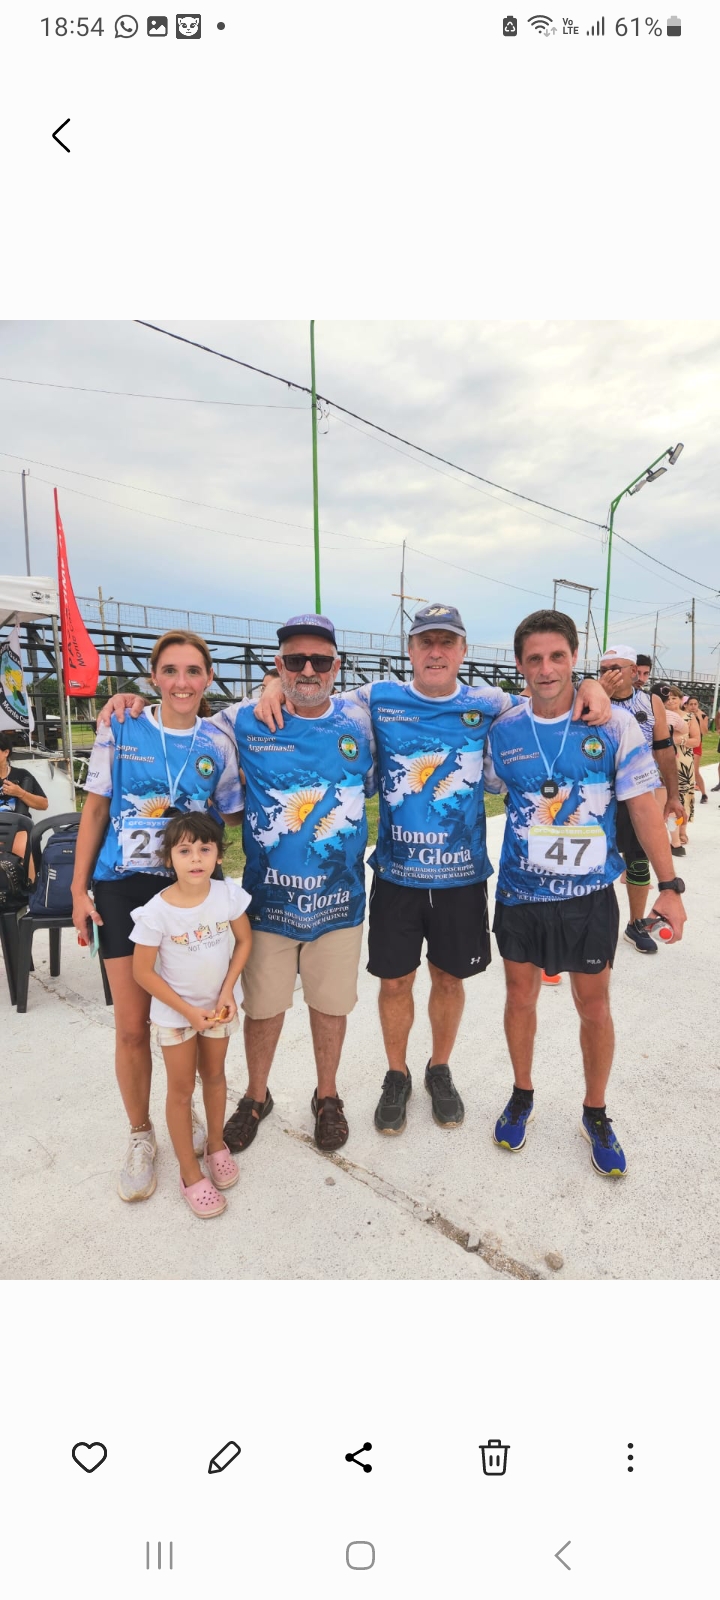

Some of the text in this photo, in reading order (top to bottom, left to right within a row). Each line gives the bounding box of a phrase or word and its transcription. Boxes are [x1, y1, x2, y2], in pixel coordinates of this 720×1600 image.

[391, 824, 448, 844] Honor
[408, 846, 472, 865] y Gloria
[545, 837, 592, 866] 47
[263, 867, 327, 891] Honor
[539, 877, 547, 887] y
[287, 888, 350, 914] y Gloria
[187, 944, 201, 952] NOT
